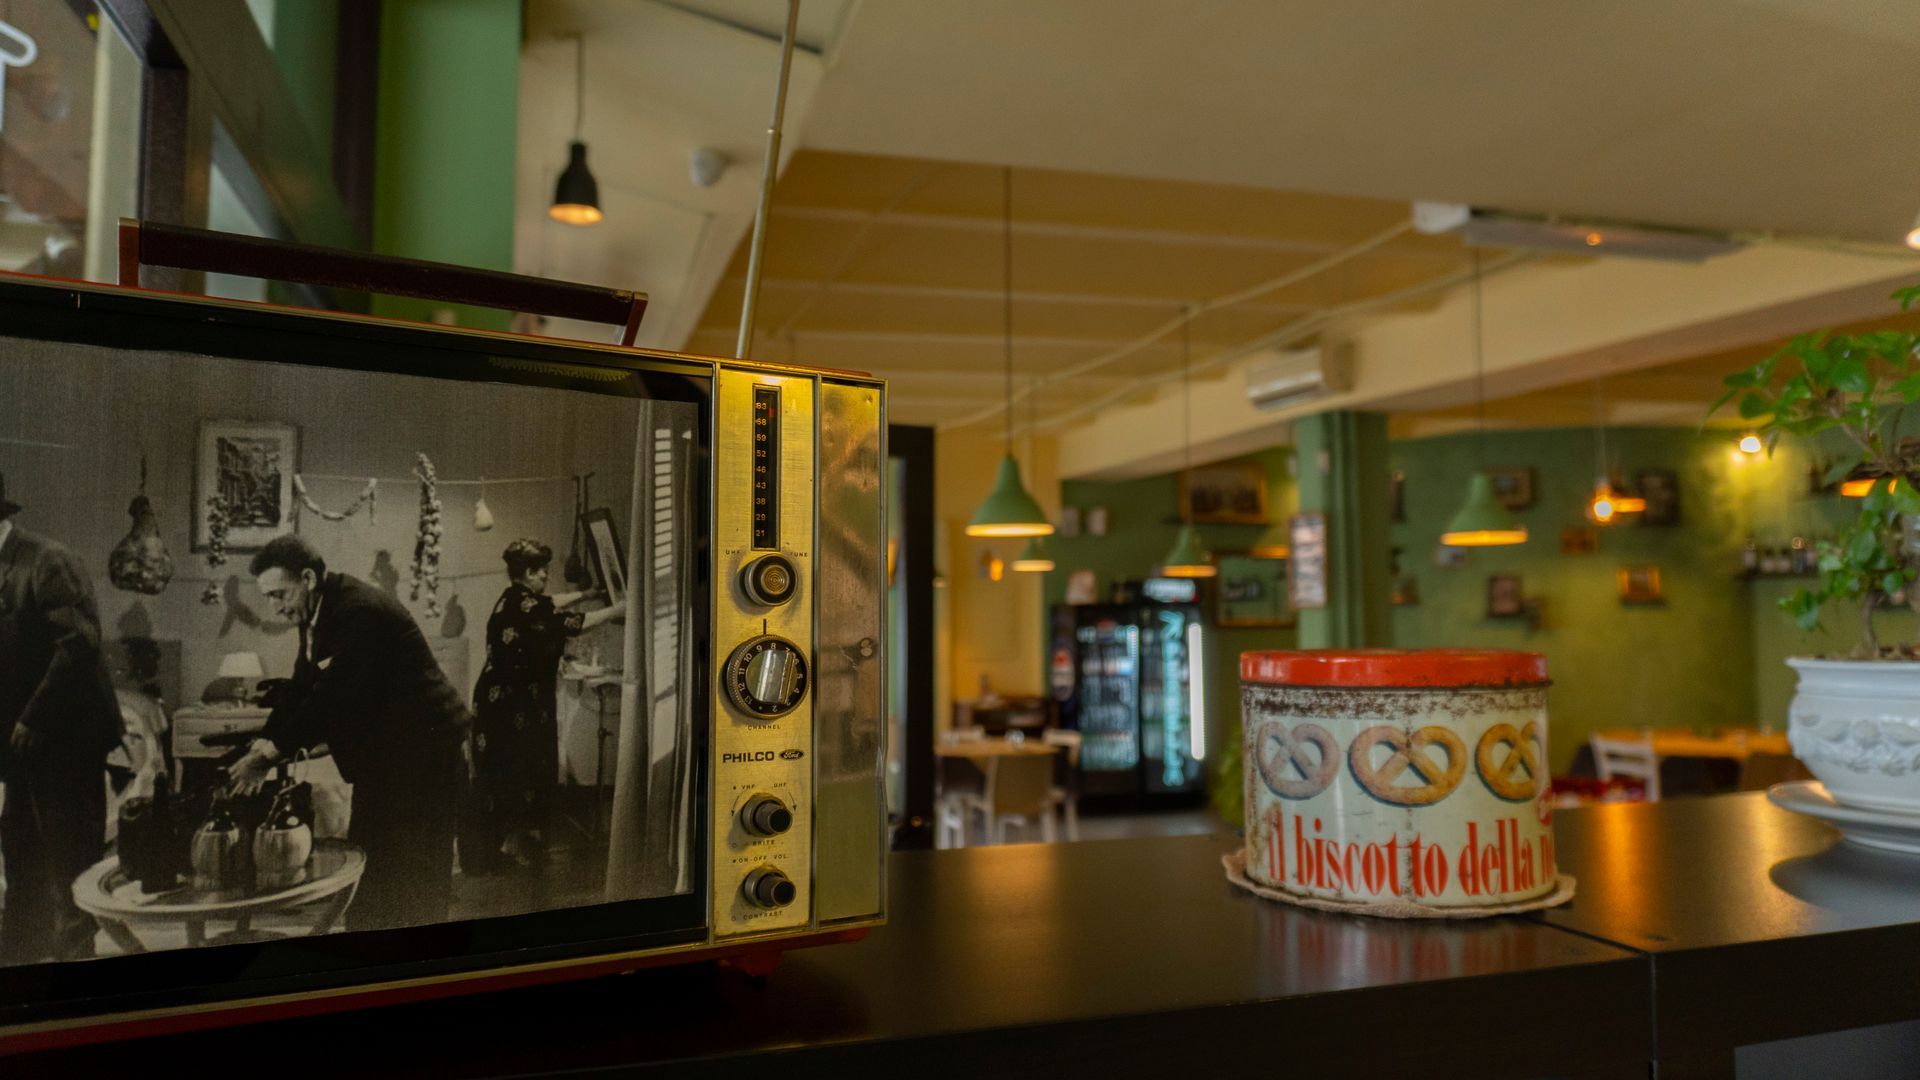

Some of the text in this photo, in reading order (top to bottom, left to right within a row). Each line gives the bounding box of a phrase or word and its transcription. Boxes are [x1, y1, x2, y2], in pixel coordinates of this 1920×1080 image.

[756, 644, 763, 652] 9
[770, 642, 777, 650] 8
[743, 653, 753, 663] 10
[738, 667, 745, 675] 11
[722, 751, 775, 764] PHILCO
[1293, 814, 1449, 898] biscotto
[1458, 818, 1535, 897] della
[743, 911, 783, 920] CONTRAST
